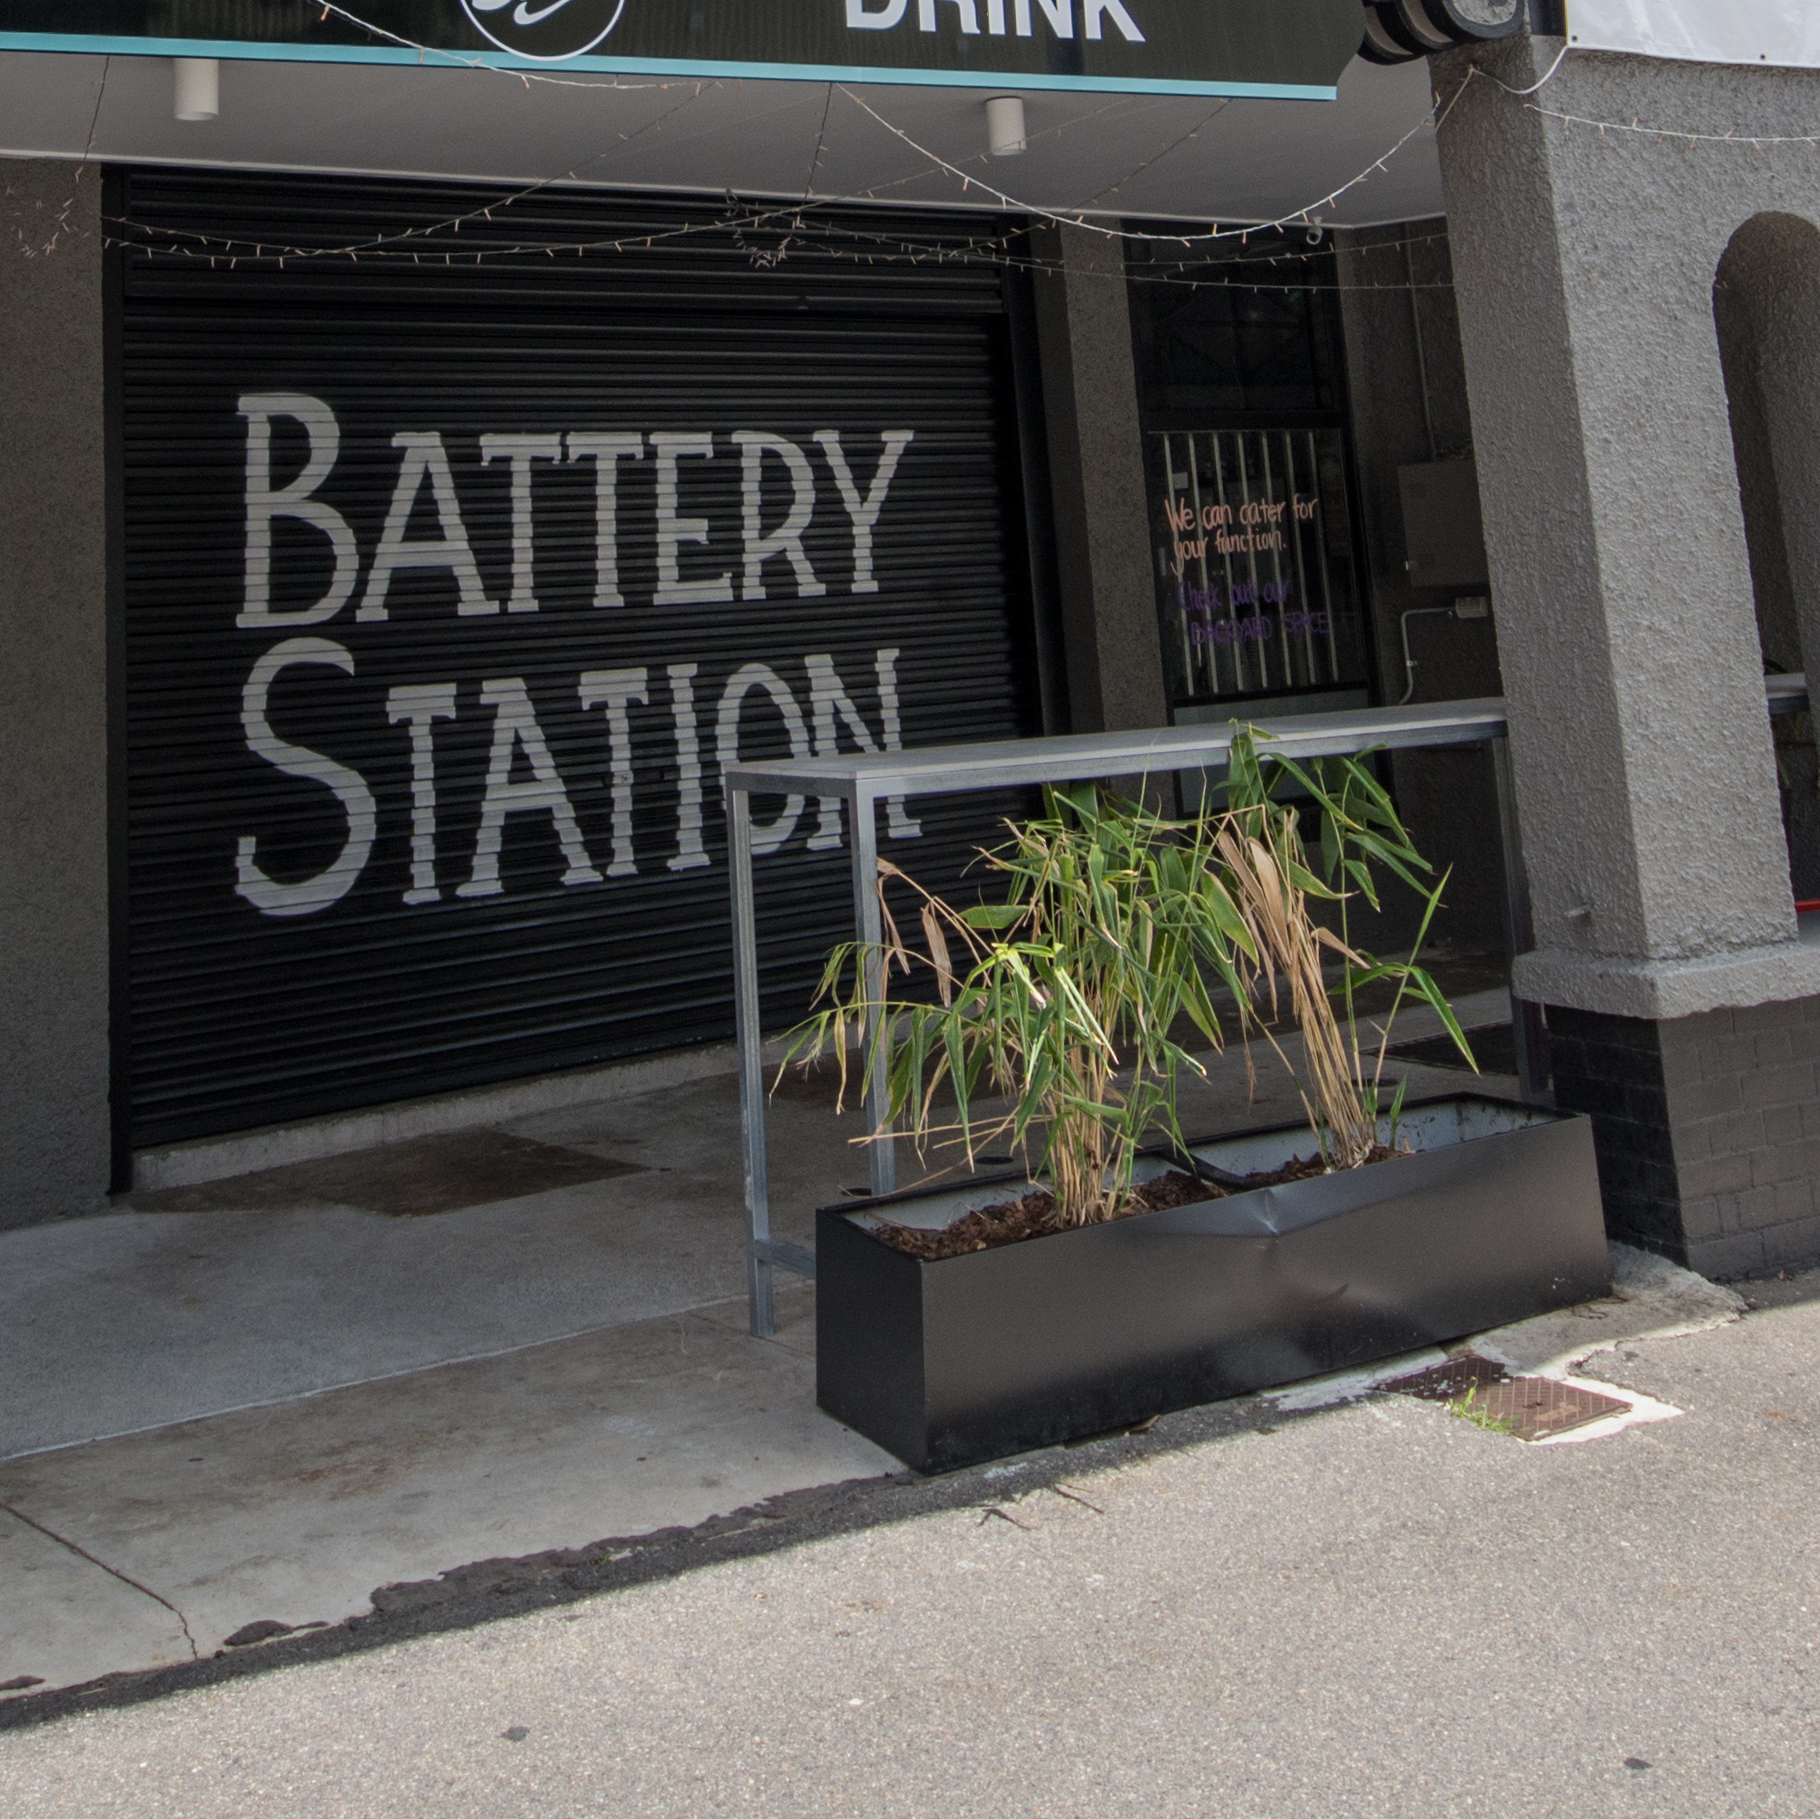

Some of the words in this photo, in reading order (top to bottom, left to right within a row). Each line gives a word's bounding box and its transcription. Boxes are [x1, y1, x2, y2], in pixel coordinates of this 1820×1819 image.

[235, 391, 915, 629] BATTERY
[1165, 498, 1196, 531] We
[1202, 503, 1233, 530] can
[1240, 498, 1286, 525] cater
[1292, 493, 1319, 520] for
[1170, 536, 1209, 576] your
[233, 637, 922, 917] STATION
